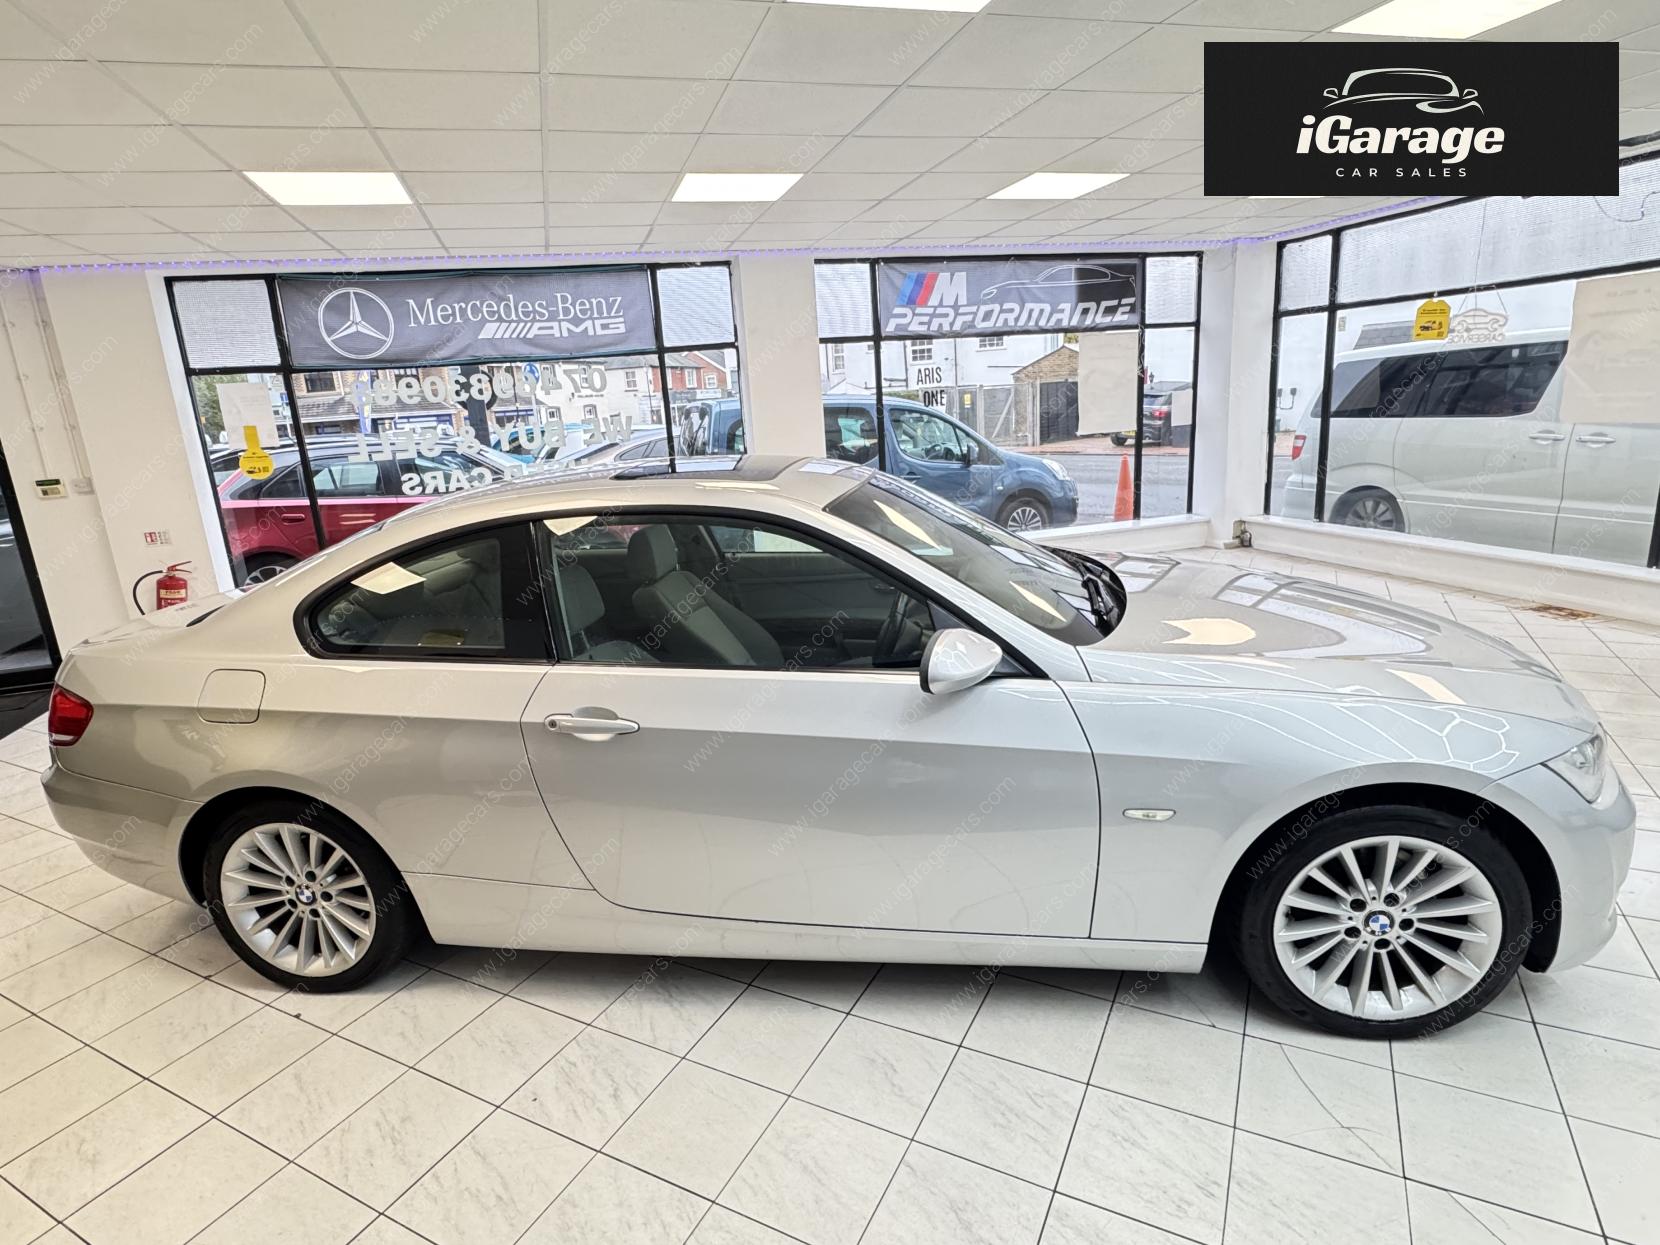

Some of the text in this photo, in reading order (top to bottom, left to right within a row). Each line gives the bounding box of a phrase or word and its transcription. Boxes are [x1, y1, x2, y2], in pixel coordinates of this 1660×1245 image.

[407, 292, 624, 327] Mercedes-Benz
[886, 297, 1136, 332] PERFORMANCE
[917, 366, 942, 385] ARIS
[923, 389, 946, 408] ONE
